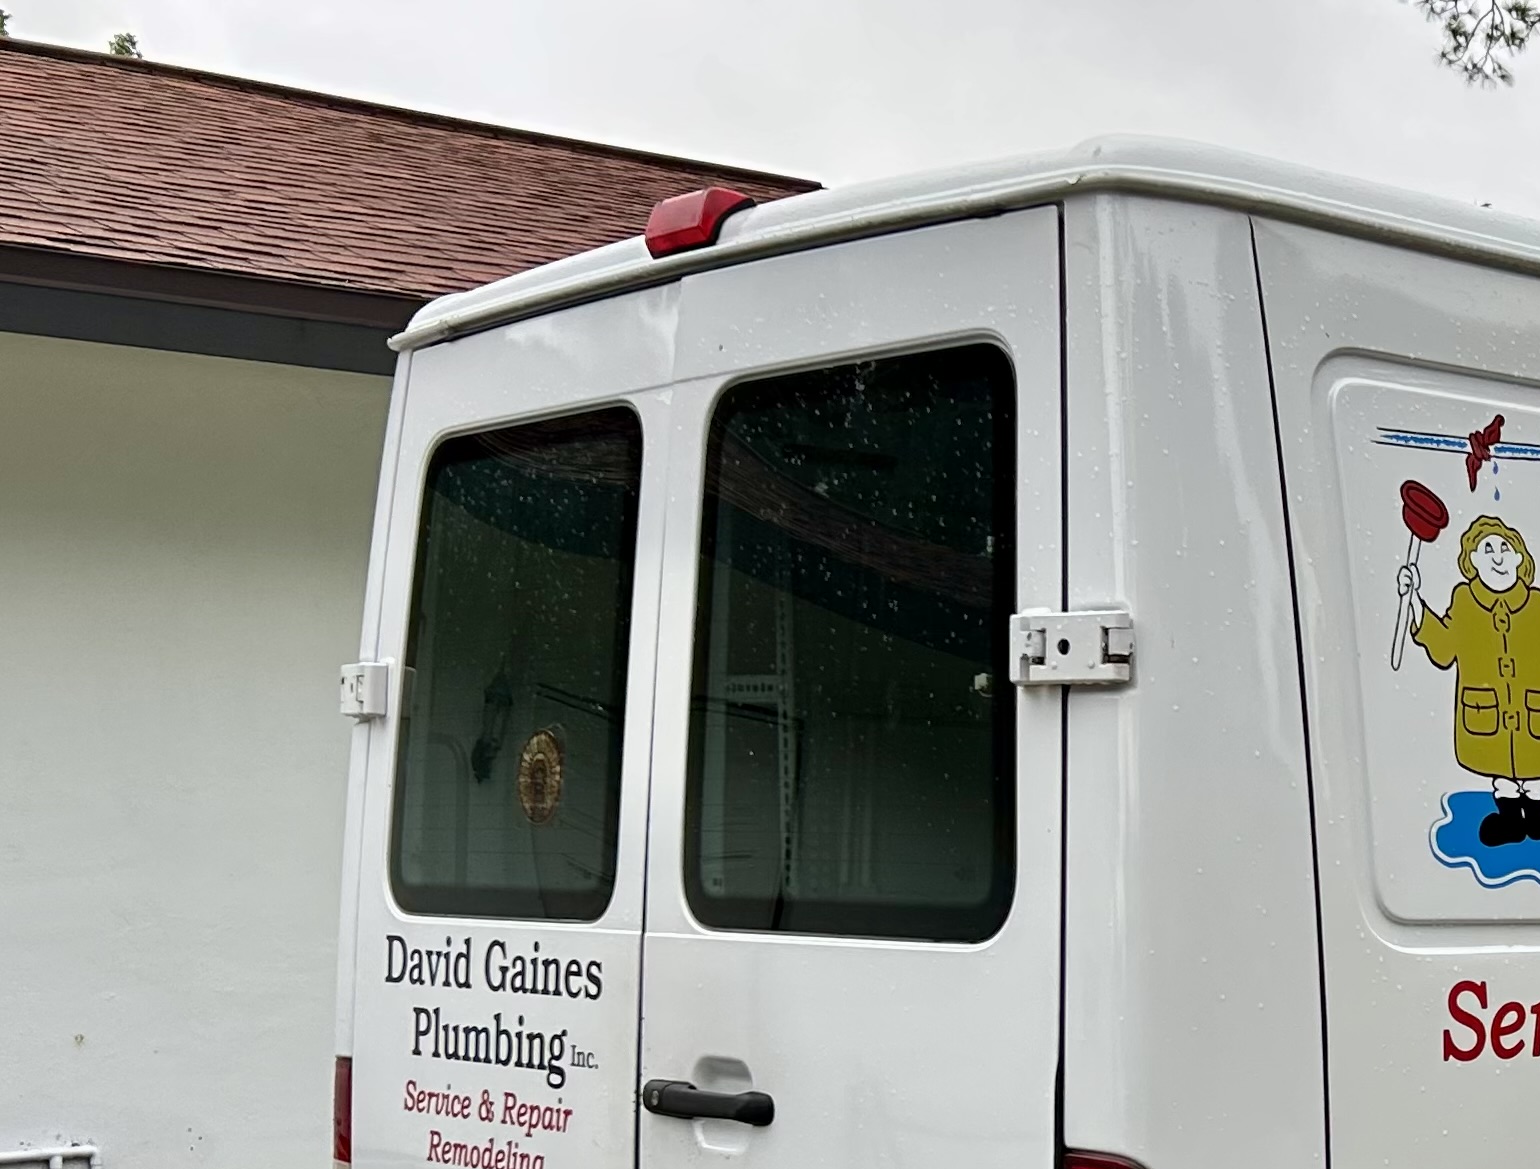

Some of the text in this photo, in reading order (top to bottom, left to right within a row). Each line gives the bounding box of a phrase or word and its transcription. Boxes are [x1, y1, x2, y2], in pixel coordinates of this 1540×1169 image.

[385, 935, 602, 1000] David Gaines
[412, 1007, 598, 1089] Plumbing Inc.
[404, 1080, 572, 1137] Service & Repair
